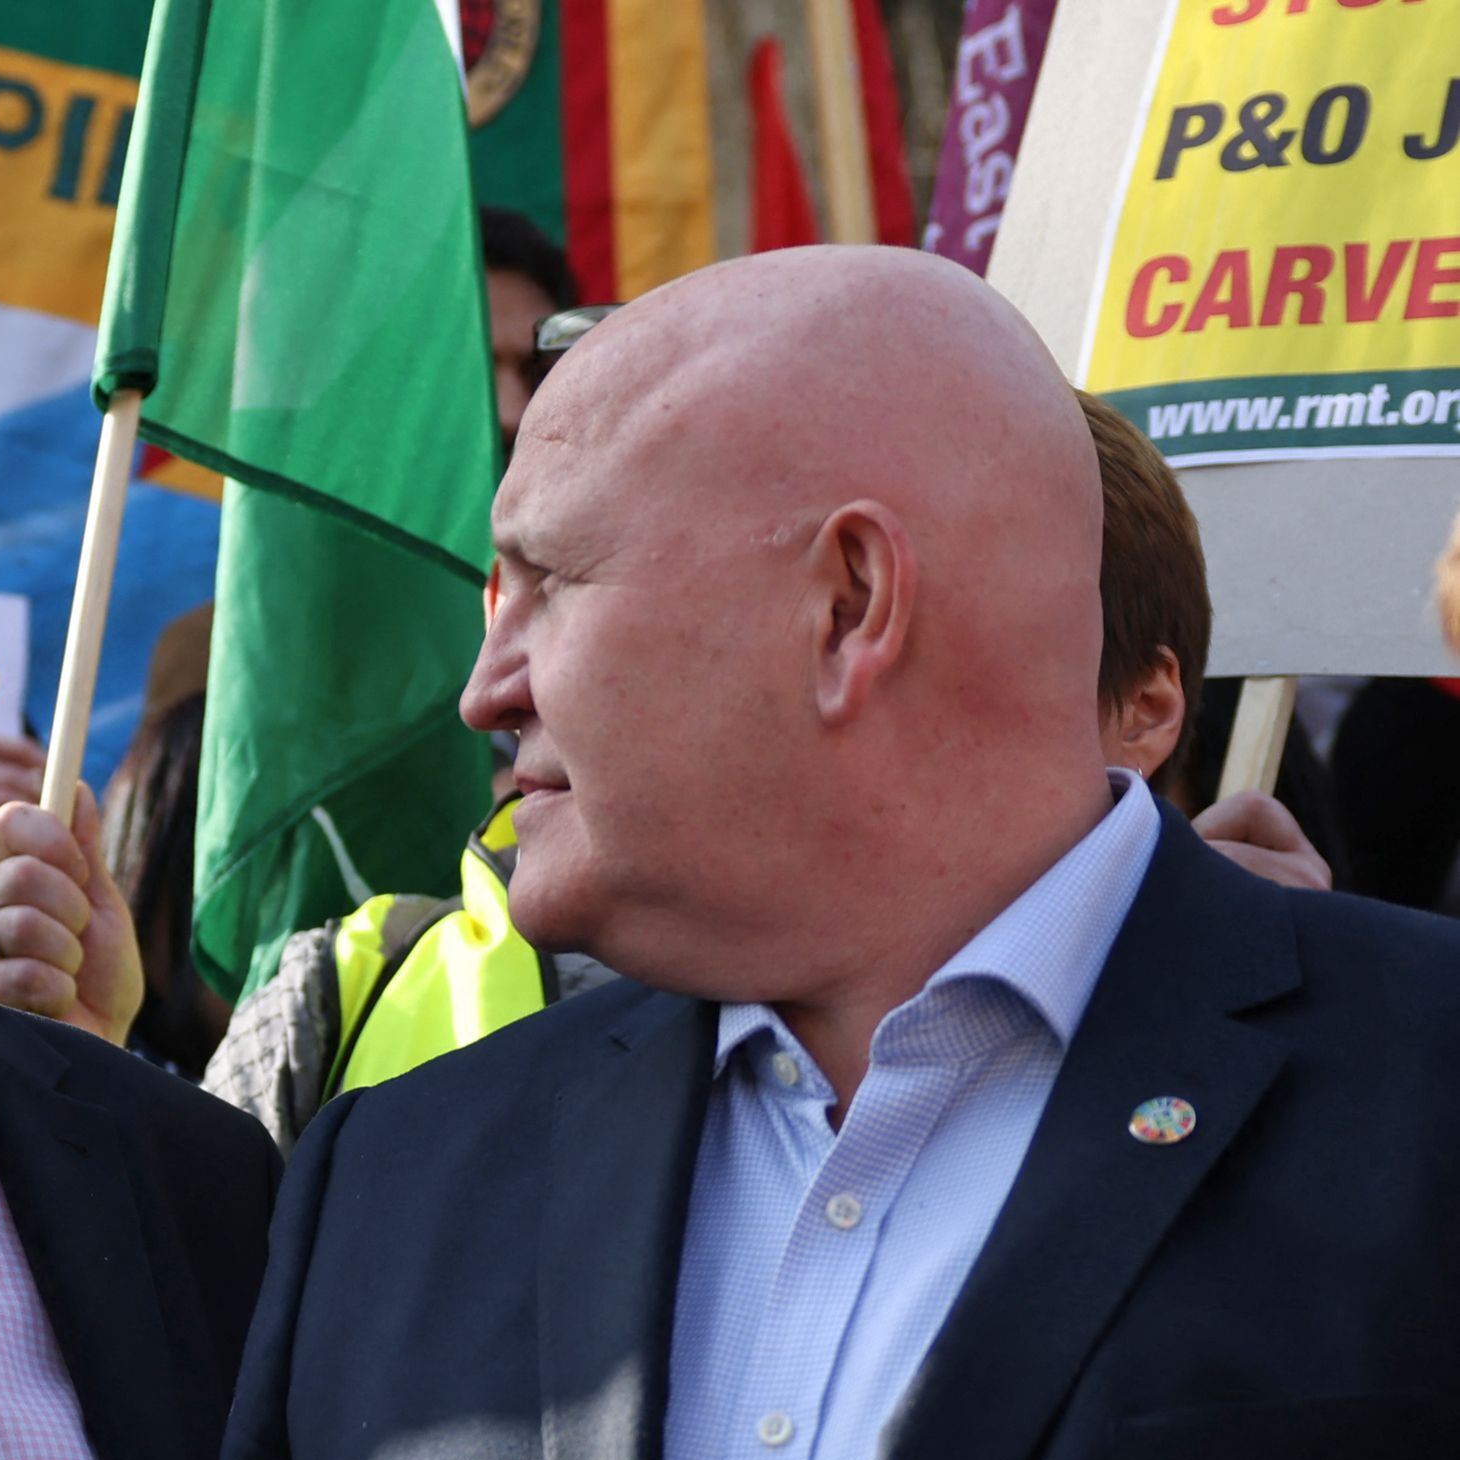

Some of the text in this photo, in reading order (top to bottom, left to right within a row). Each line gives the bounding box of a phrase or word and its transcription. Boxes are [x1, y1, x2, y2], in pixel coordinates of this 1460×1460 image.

[1154, 83, 1373, 181] P&O
[1124, 236, 1460, 340] CARVE
[1147, 383, 1460, 440] www.rmt.or
